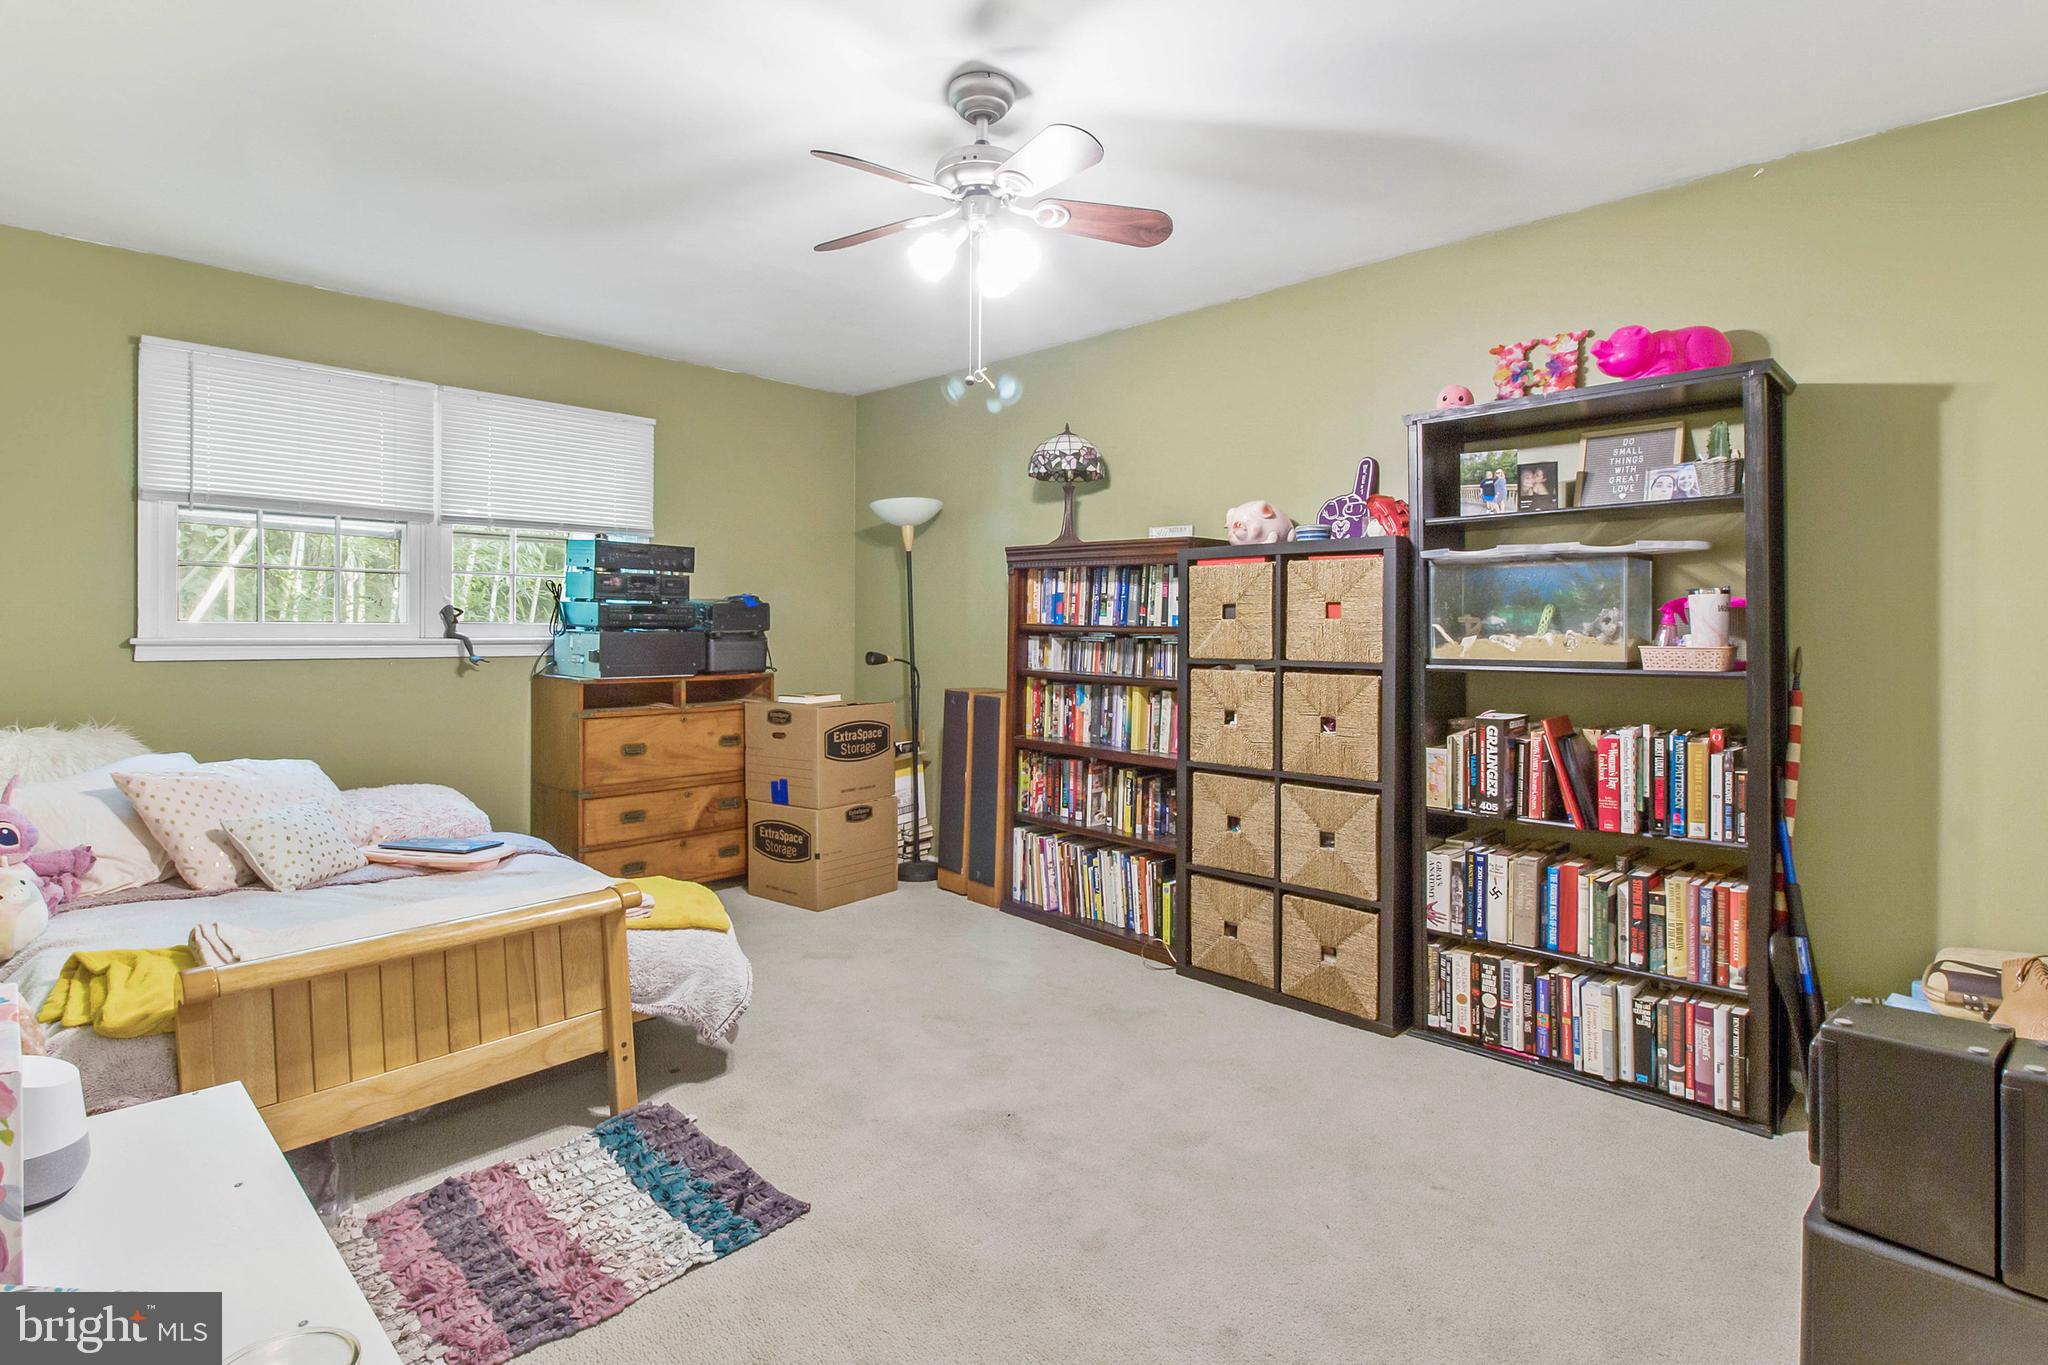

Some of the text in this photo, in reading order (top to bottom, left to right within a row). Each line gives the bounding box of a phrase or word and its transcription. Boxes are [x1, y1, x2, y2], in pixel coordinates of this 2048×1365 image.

[1623, 438, 1635, 446] DO
[1613, 447, 1643, 456] SMALL
[1610, 455, 1644, 465] THINGS
[1615, 466, 1637, 474] WITH
[1609, 474, 1639, 484] GREAT
[1612, 484, 1635, 494] LOVE
[833, 728, 883, 743] ExtraSpace
[840, 742, 876, 755] Storage
[1486, 725, 1498, 798] GRAINGER
[1599, 753, 1608, 783] Cookbook
[1608, 749, 1618, 776] Woman's
[1674, 740, 1684, 809] JAMES PATTERSON
[1606, 777, 1618, 790] Day
[1479, 801, 1498, 811] 405
[760, 826, 804, 844] ExtraSpace
[764, 839, 797, 858] Storage
[1632, 879, 1643, 904] STEPHEN
[1632, 905, 1643, 920] KING
[1702, 1027, 1711, 1061] Churchill's
